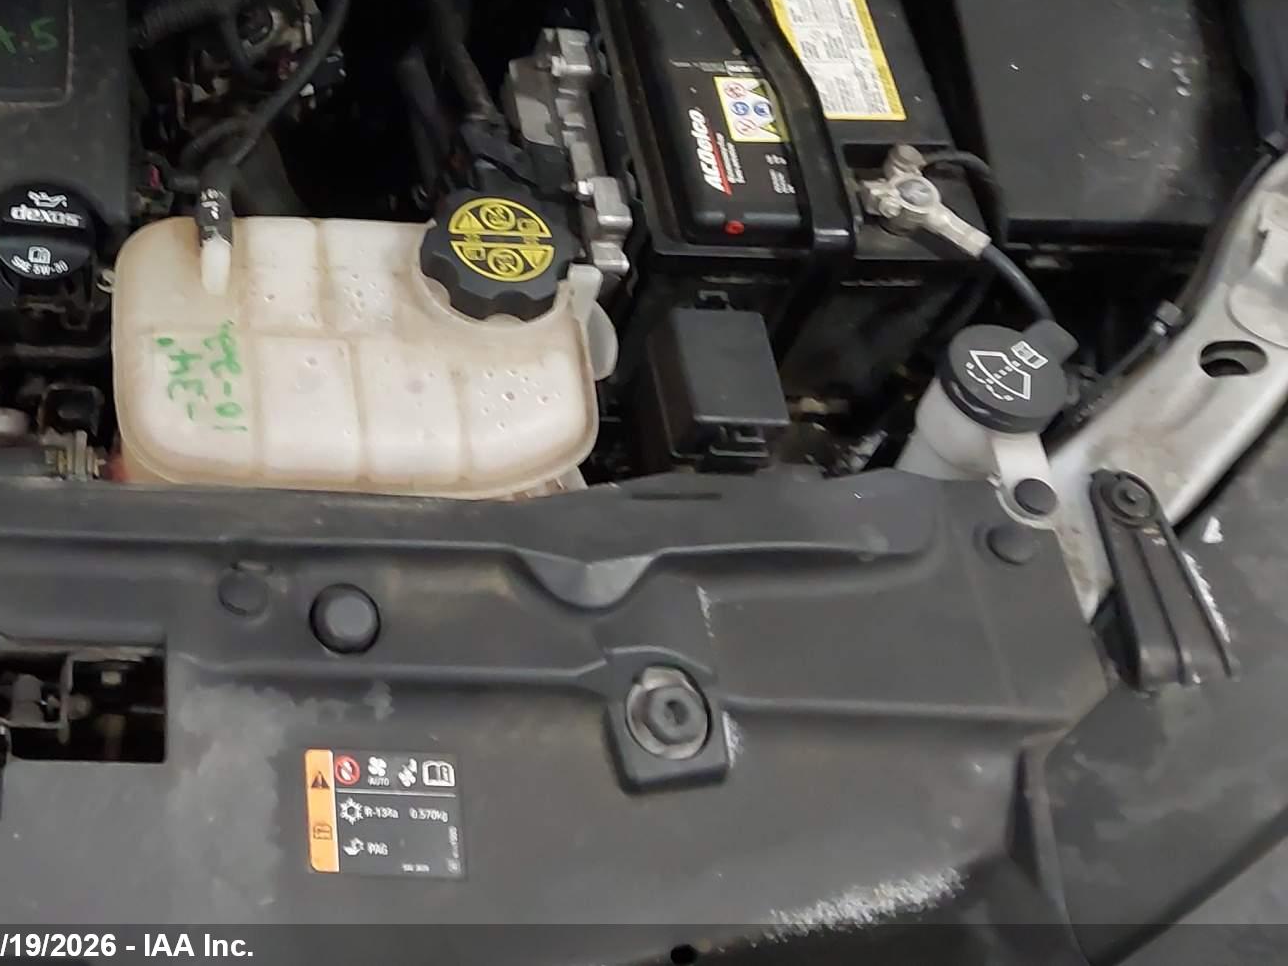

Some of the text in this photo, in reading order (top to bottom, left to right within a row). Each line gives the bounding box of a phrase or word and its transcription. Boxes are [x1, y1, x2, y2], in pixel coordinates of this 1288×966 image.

[688, 109, 726, 191] ACDelco
[10, 204, 82, 227] dexos
[368, 777, 390, 786] AUTO
[367, 841, 389, 856] PAG
